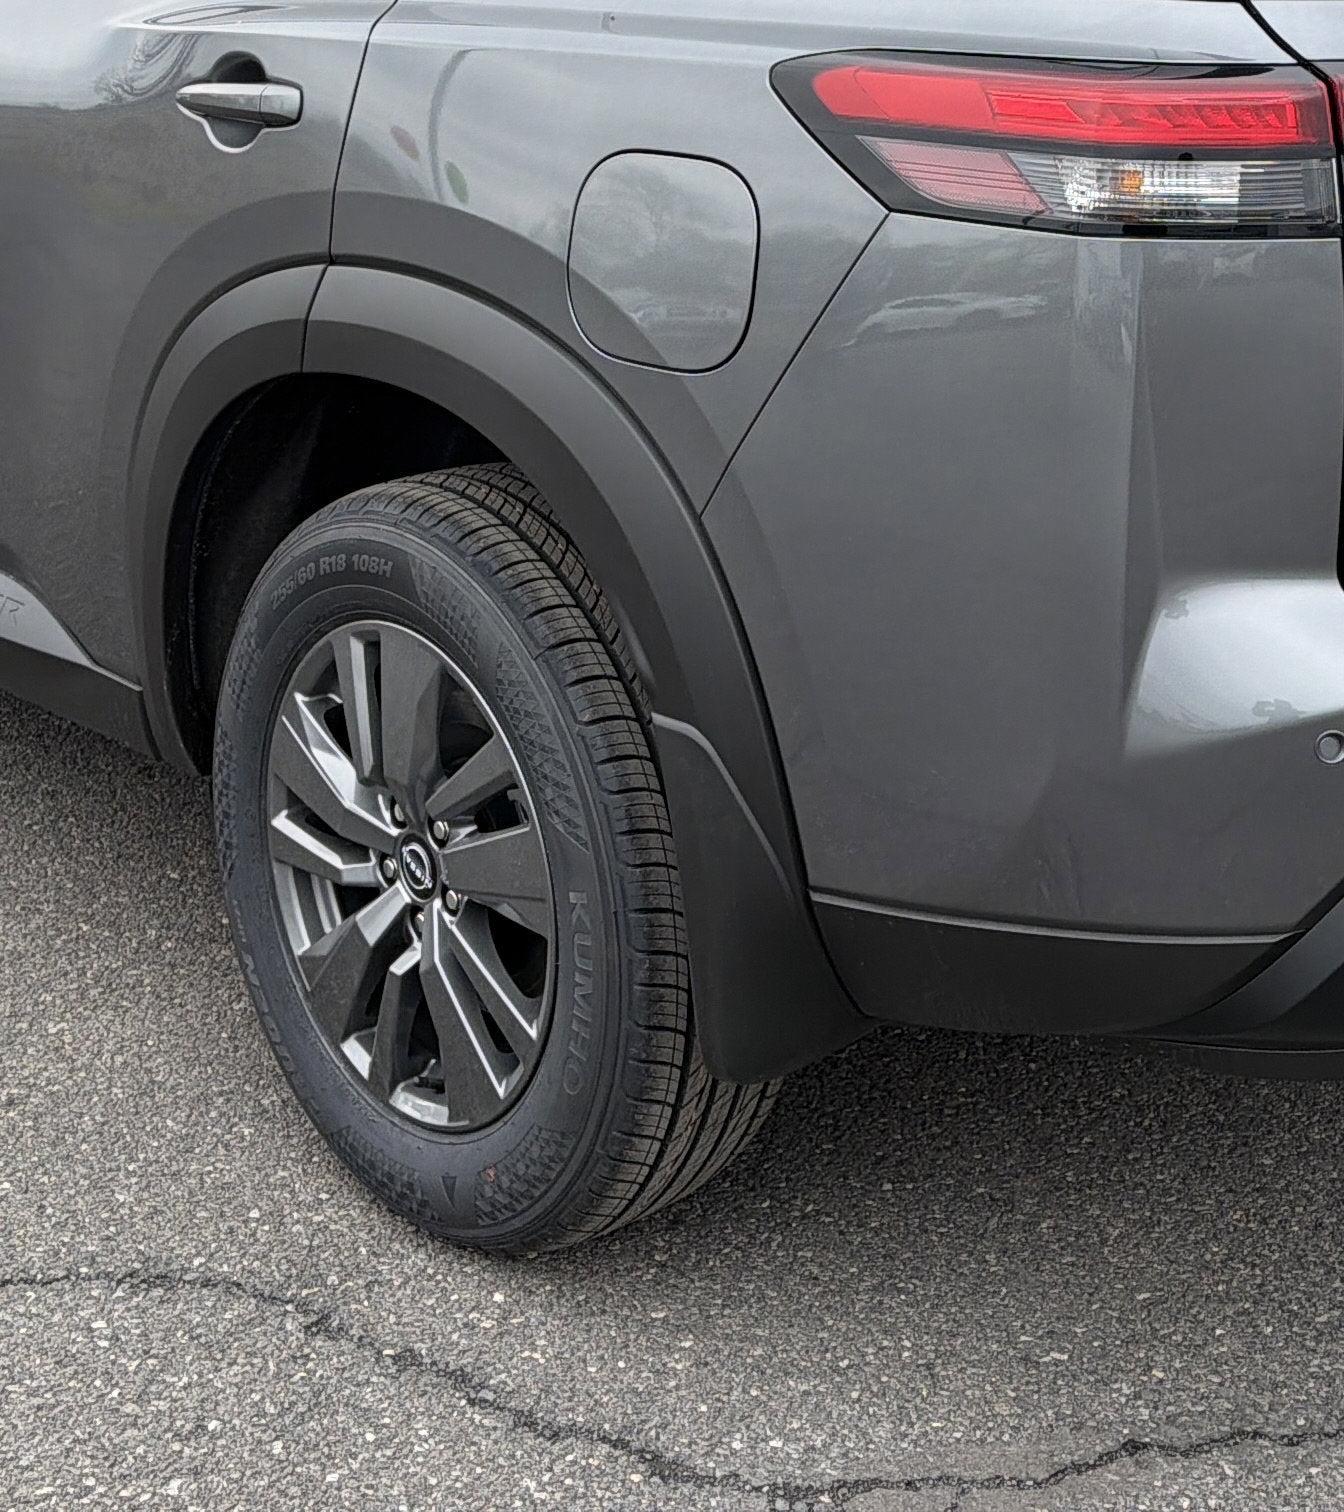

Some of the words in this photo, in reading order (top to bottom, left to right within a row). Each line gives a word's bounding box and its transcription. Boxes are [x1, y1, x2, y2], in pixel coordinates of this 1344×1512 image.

[319, 553, 347, 576] R18
[351, 554, 394, 578] 108H
[563, 891, 593, 1095] KUMHO
